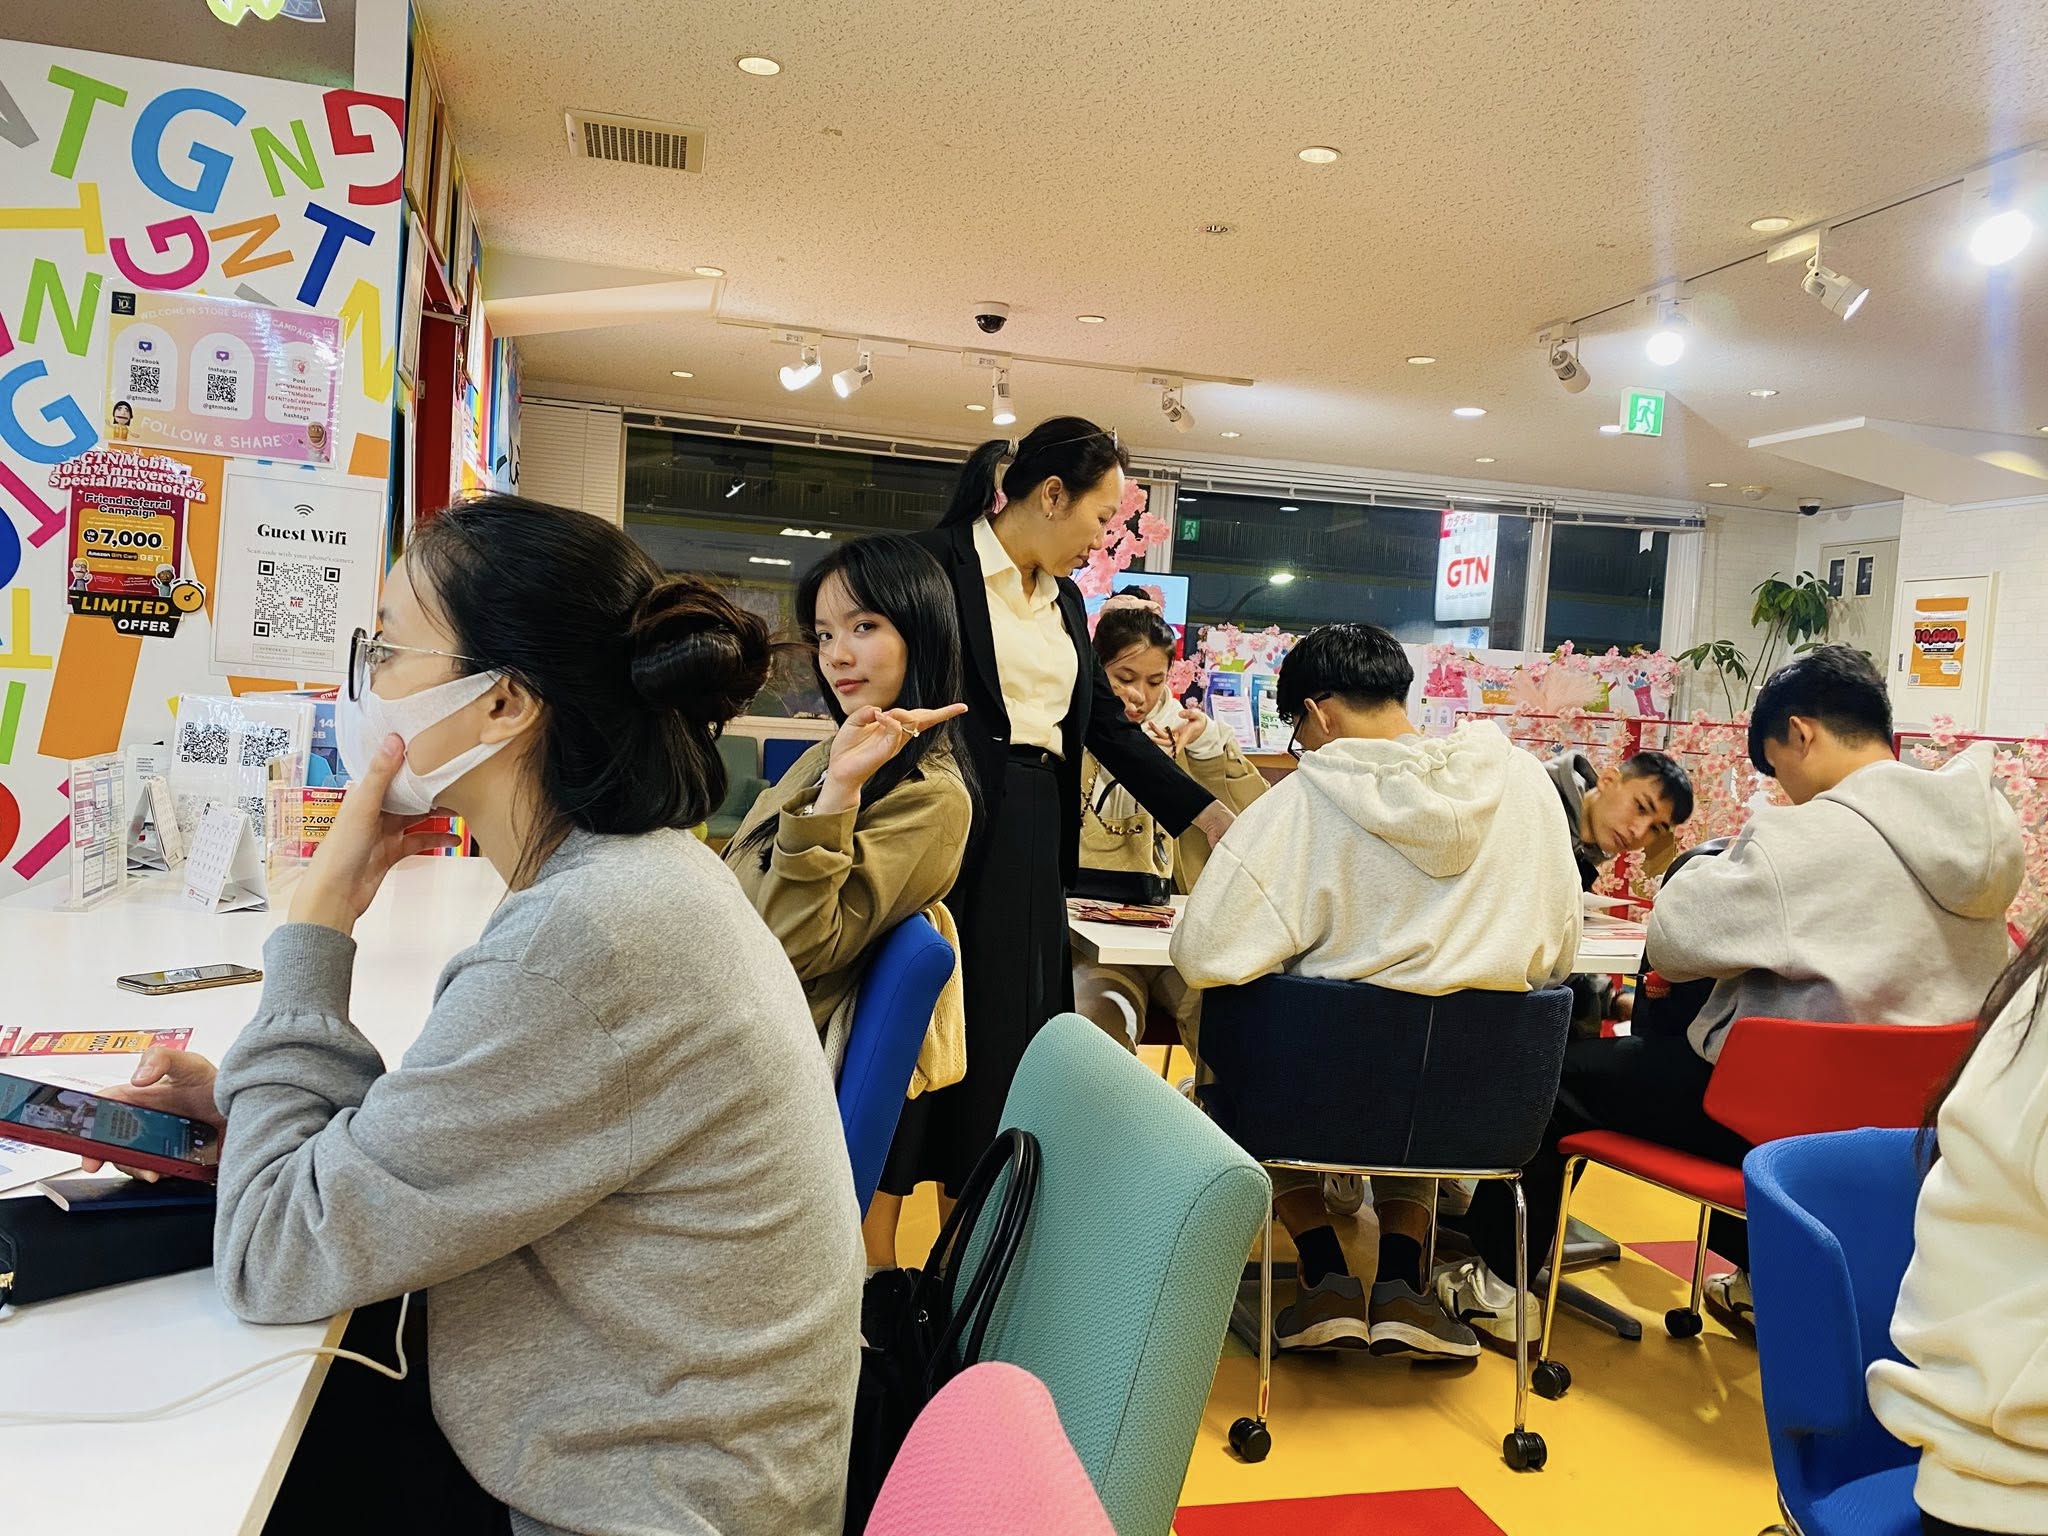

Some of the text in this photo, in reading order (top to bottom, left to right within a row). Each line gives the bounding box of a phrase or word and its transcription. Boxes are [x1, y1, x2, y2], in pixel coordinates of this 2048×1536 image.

[198, 306, 228, 318] STORE
[271, 318, 318, 342] CAMPAIG
[131, 356, 160, 366] Facebook
[207, 366, 238, 375] Instagram
[292, 377, 306, 385] Post
[126, 394, 162, 404] @gtnmobile
[202, 402, 238, 412] @gtnmobile
[282, 404, 311, 413] Campaign
[283, 412, 310, 421] hashtags
[139, 415, 283, 449] FOLLOW & SHARE
[80, 451, 119, 466] GTN
[53, 462, 205, 492] 10th Anniversary
[49, 474, 206, 502] Special Promotion
[85, 493, 171, 509] Friend Referral
[99, 504, 156, 518] Campaign
[100, 529, 162, 548] 7,000
[257, 523, 348, 546] Guest Wifi
[139, 554, 165, 563] GET!
[278, 550, 292, 558] with
[309, 553, 332, 562] phone's
[1447, 554, 1490, 588] GTN
[80, 596, 169, 615] LIMITED
[289, 600, 303, 608] ME
[117, 619, 170, 633] OFFER
[1915, 629, 1958, 645] 10,000
